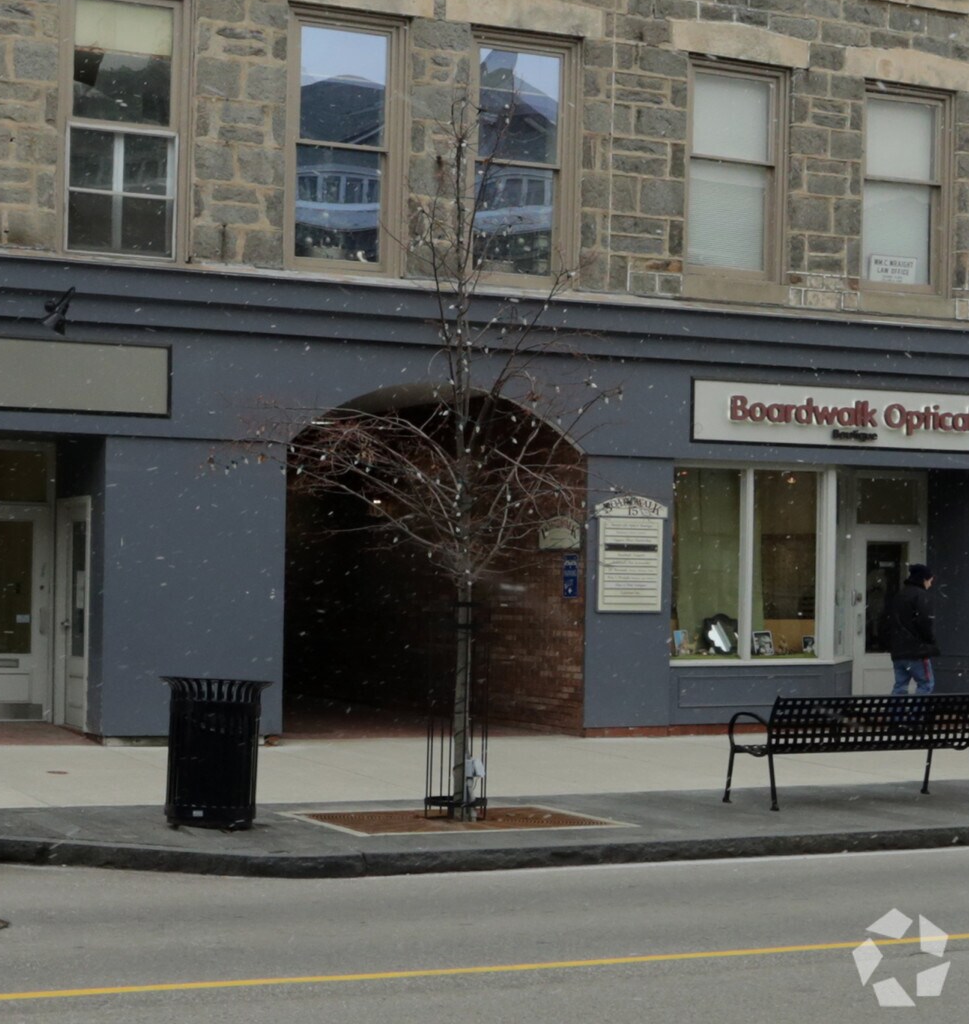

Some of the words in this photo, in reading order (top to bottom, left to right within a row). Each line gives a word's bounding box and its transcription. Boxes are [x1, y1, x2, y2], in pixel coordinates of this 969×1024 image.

[891, 268, 909, 276] OFFICE
[729, 394, 878, 427] Boardwalk
[883, 403, 969, 436] Optica
[832, 429, 878, 442] Boutique
